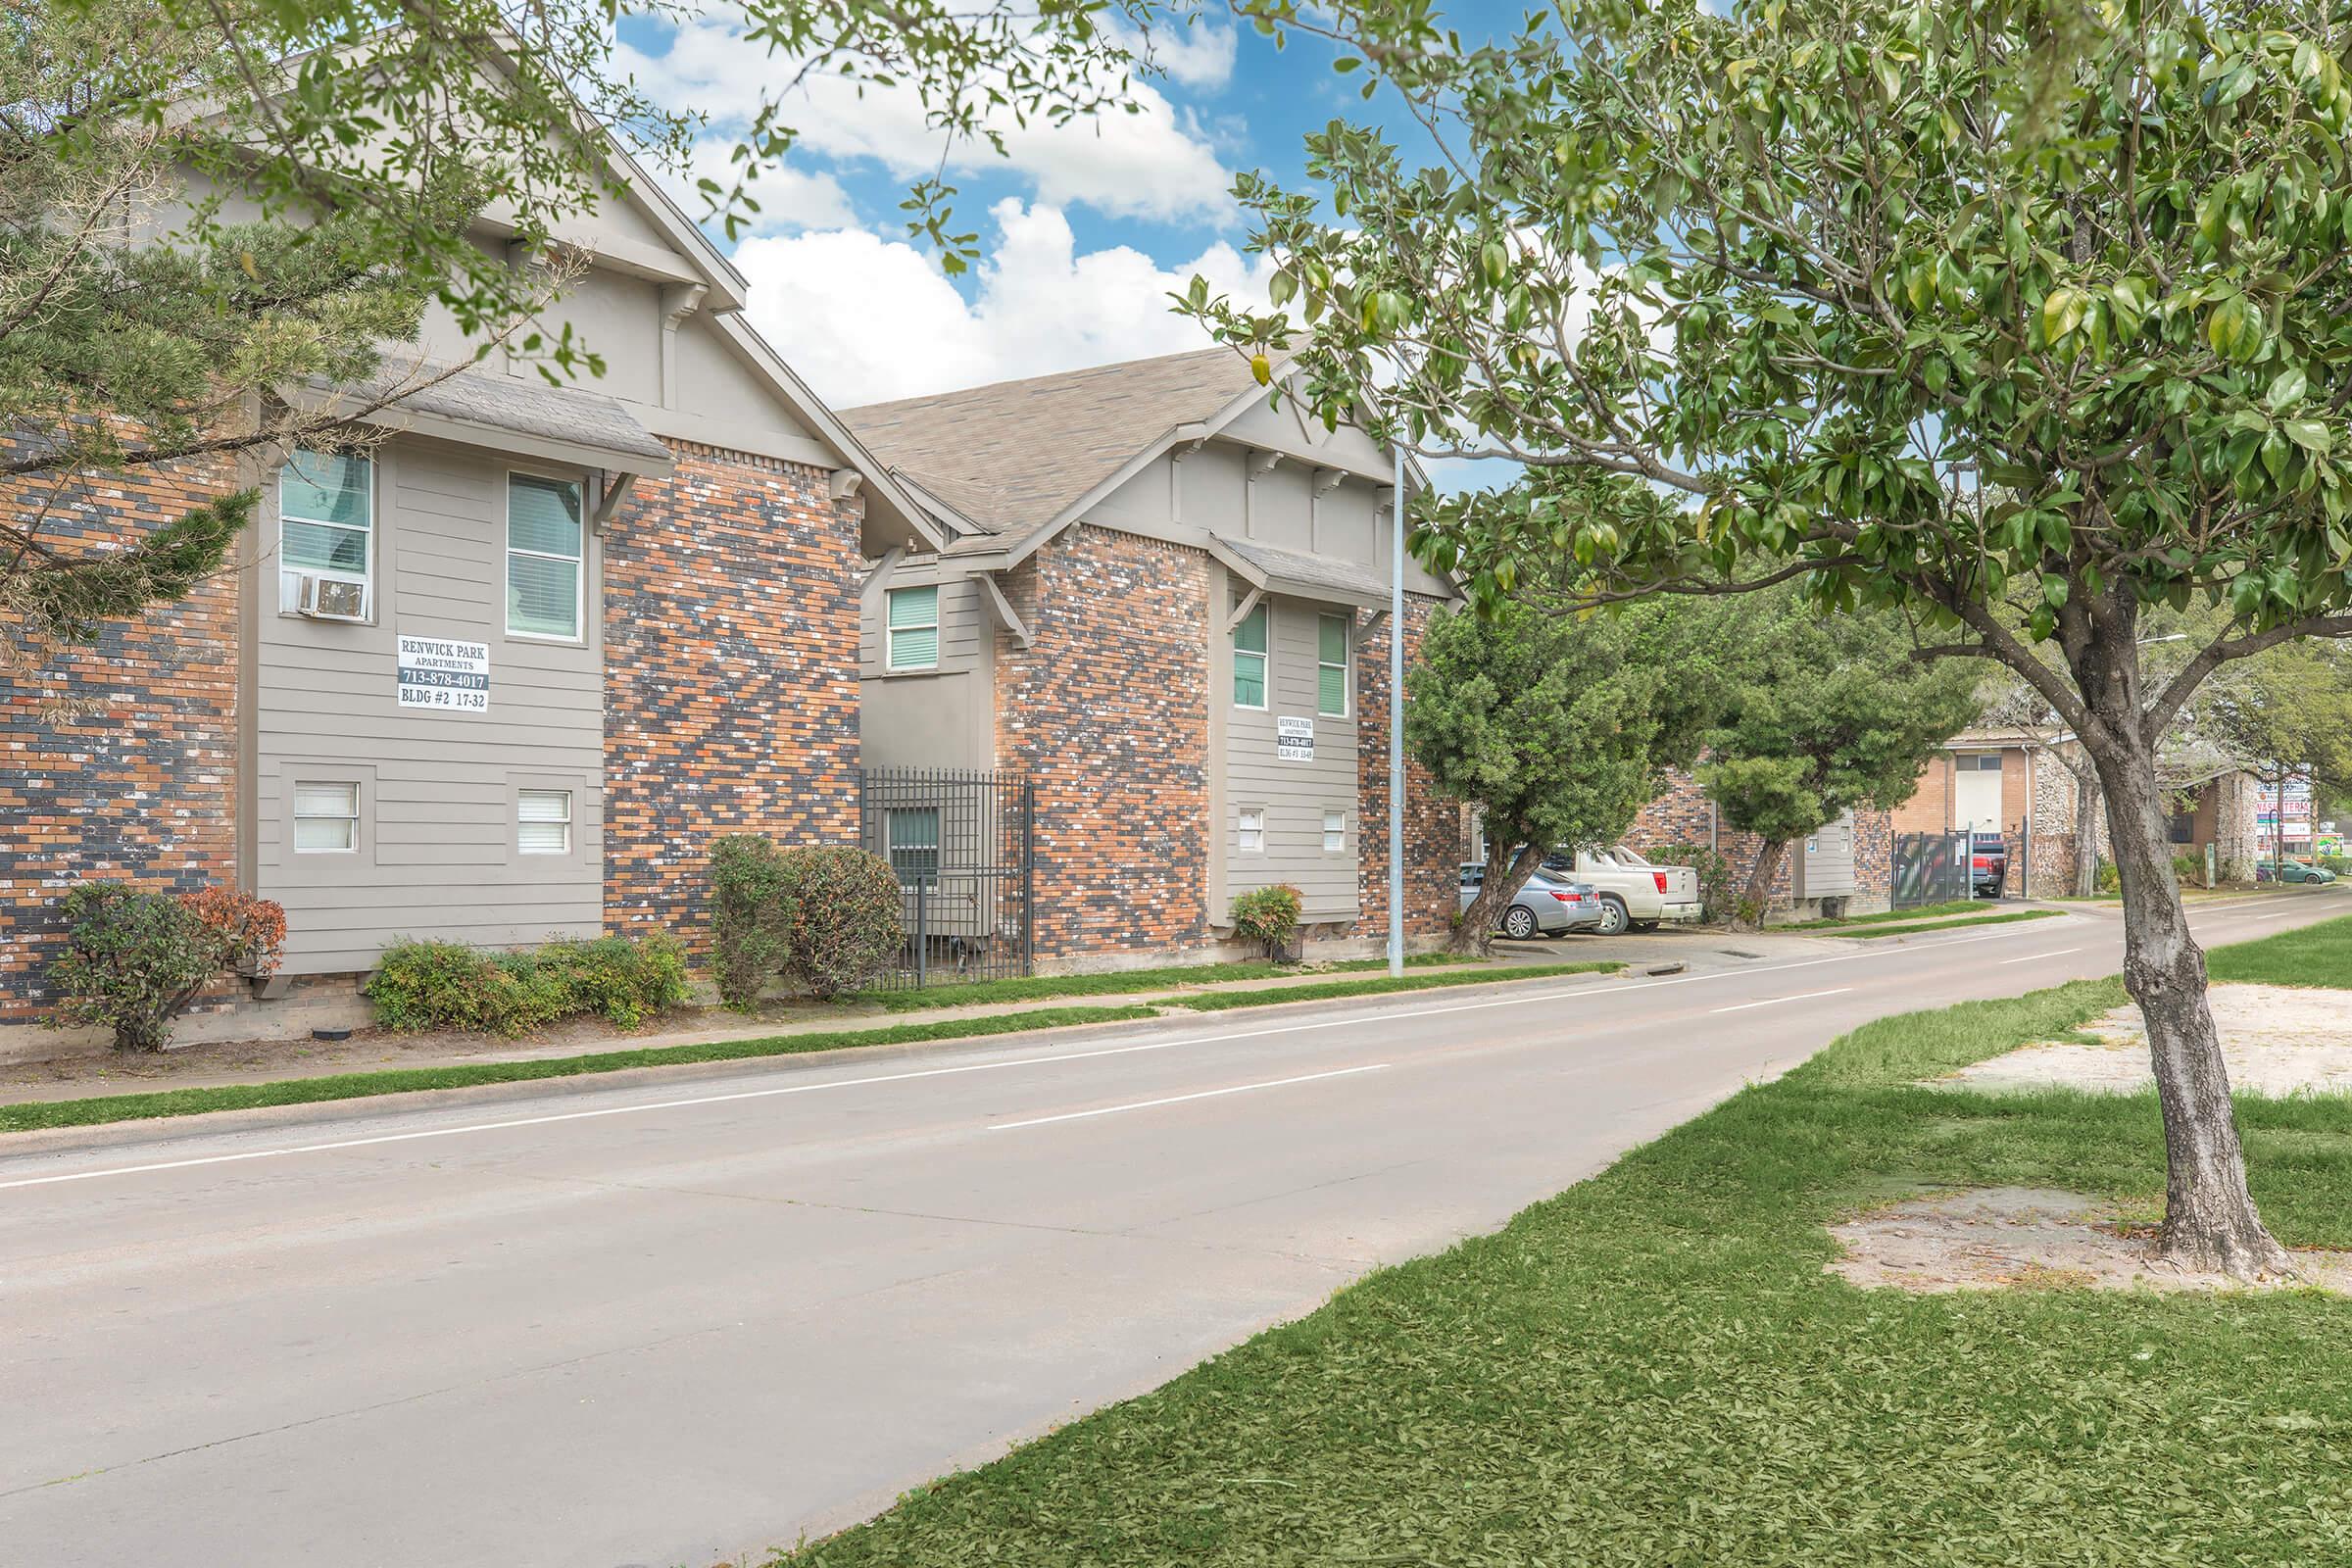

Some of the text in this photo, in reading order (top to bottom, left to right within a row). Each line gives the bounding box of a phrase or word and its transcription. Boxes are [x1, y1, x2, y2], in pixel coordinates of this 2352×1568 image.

[402, 640, 485, 660] RENWICK PARK
[416, 657, 474, 670] APARTMENTS
[403, 670, 484, 688] 713-878-4017
[402, 688, 484, 707] BLDG #2 17-32
